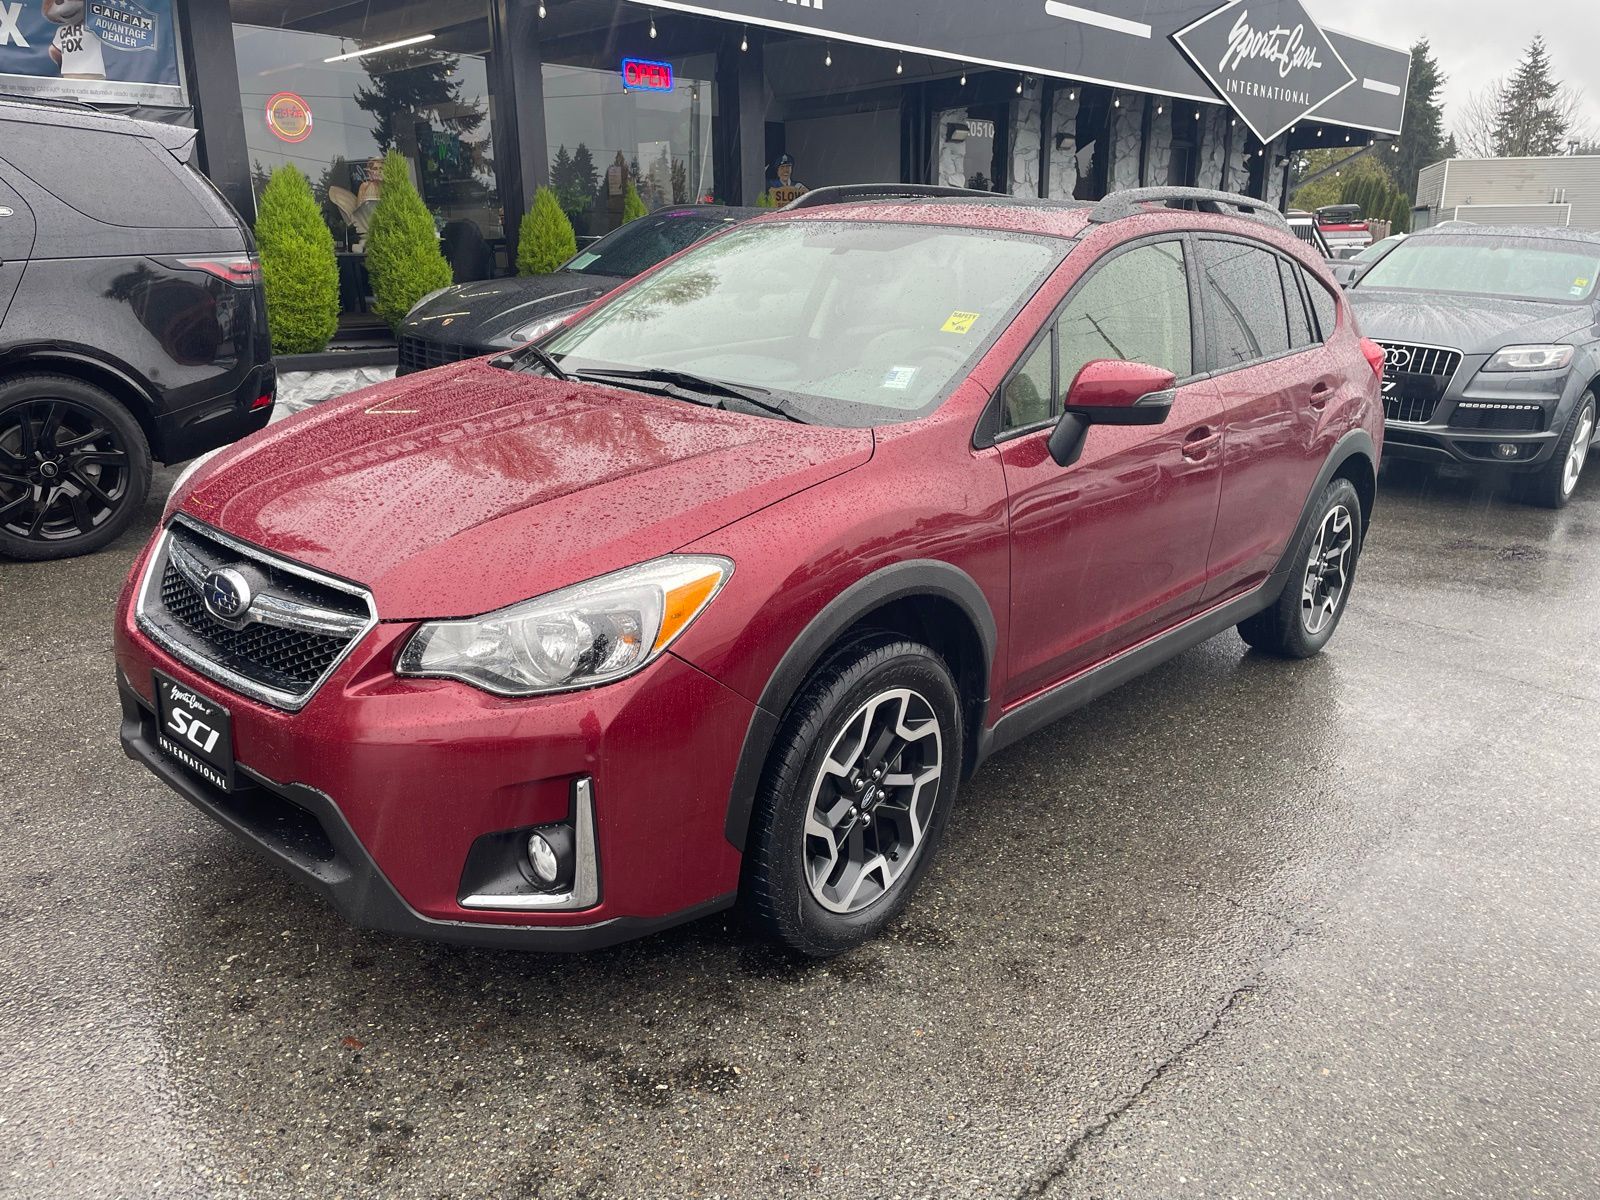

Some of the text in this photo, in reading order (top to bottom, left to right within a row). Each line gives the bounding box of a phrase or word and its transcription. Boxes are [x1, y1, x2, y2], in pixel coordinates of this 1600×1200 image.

[91, 4, 152, 30] CARFAX
[95, 18, 147, 40] ADVANTAGE
[59, 24, 83, 40] CAR
[102, 29, 137, 47] DEALER
[1218, 9, 1322, 78] Sports Cars
[62, 38, 83, 53] FOX
[626, 62, 670, 88] OPEN
[1226, 79, 1310, 105] INTERNATIONAL
[167, 707, 220, 753] SCI
[160, 736, 227, 790] INTERNATIONAL
